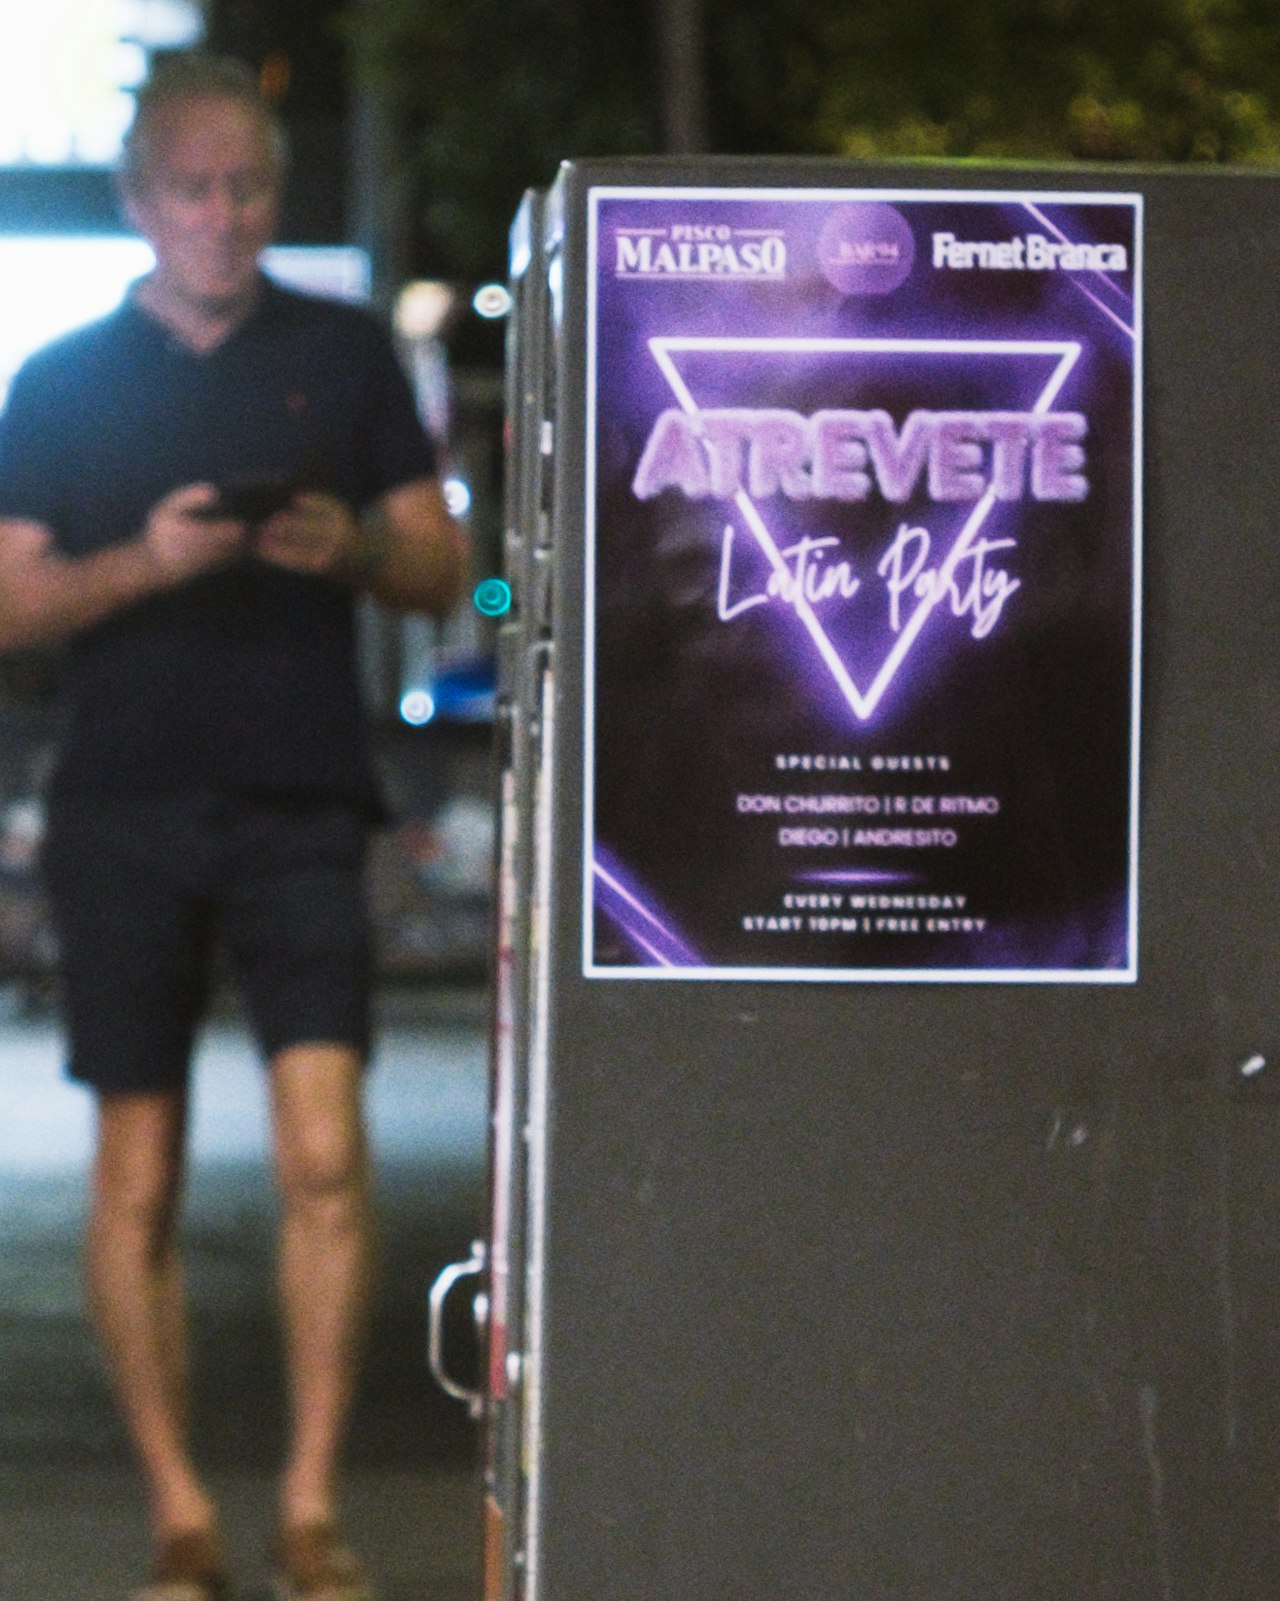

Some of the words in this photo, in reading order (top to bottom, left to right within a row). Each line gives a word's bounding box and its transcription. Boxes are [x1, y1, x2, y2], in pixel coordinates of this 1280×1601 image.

[670, 224, 732, 241] PISCO
[615, 235, 787, 274] MALPASO
[631, 406, 1091, 502] ATREVETE
[717, 523, 861, 622] Latin
[877, 522, 1022, 639] Party
[774, 754, 863, 771] SPECIAL
[869, 755, 952, 772] GUESTS
[736, 794, 781, 813] DON
[911, 796, 934, 814] DE
[777, 827, 839, 847] DIEGO
[853, 828, 959, 848] ANDRESITO
[782, 893, 844, 910] EVERY
[849, 894, 967, 911] WEDNESDAY
[742, 915, 803, 931] START
[808, 916, 858, 932] 10PM
[875, 917, 919, 932] FREE
[926, 917, 987, 933] ENTRY
